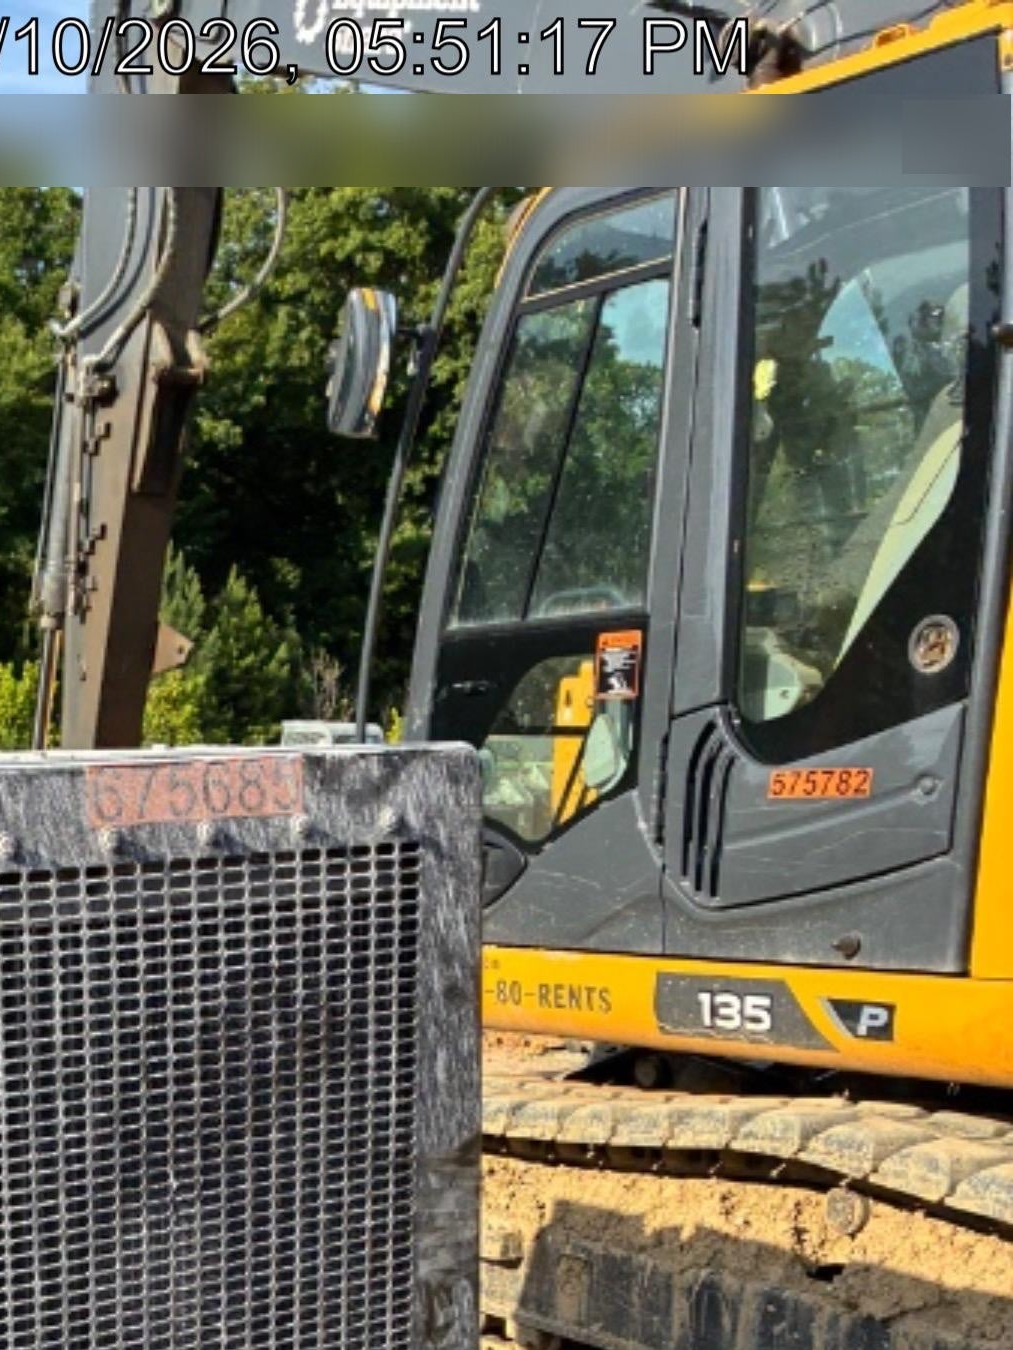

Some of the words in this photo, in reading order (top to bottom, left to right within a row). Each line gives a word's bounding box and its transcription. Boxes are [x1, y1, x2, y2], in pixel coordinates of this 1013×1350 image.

[771, 770, 870, 796] 575782
[697, 992, 772, 1031] 135
[856, 1005, 888, 1036] P
